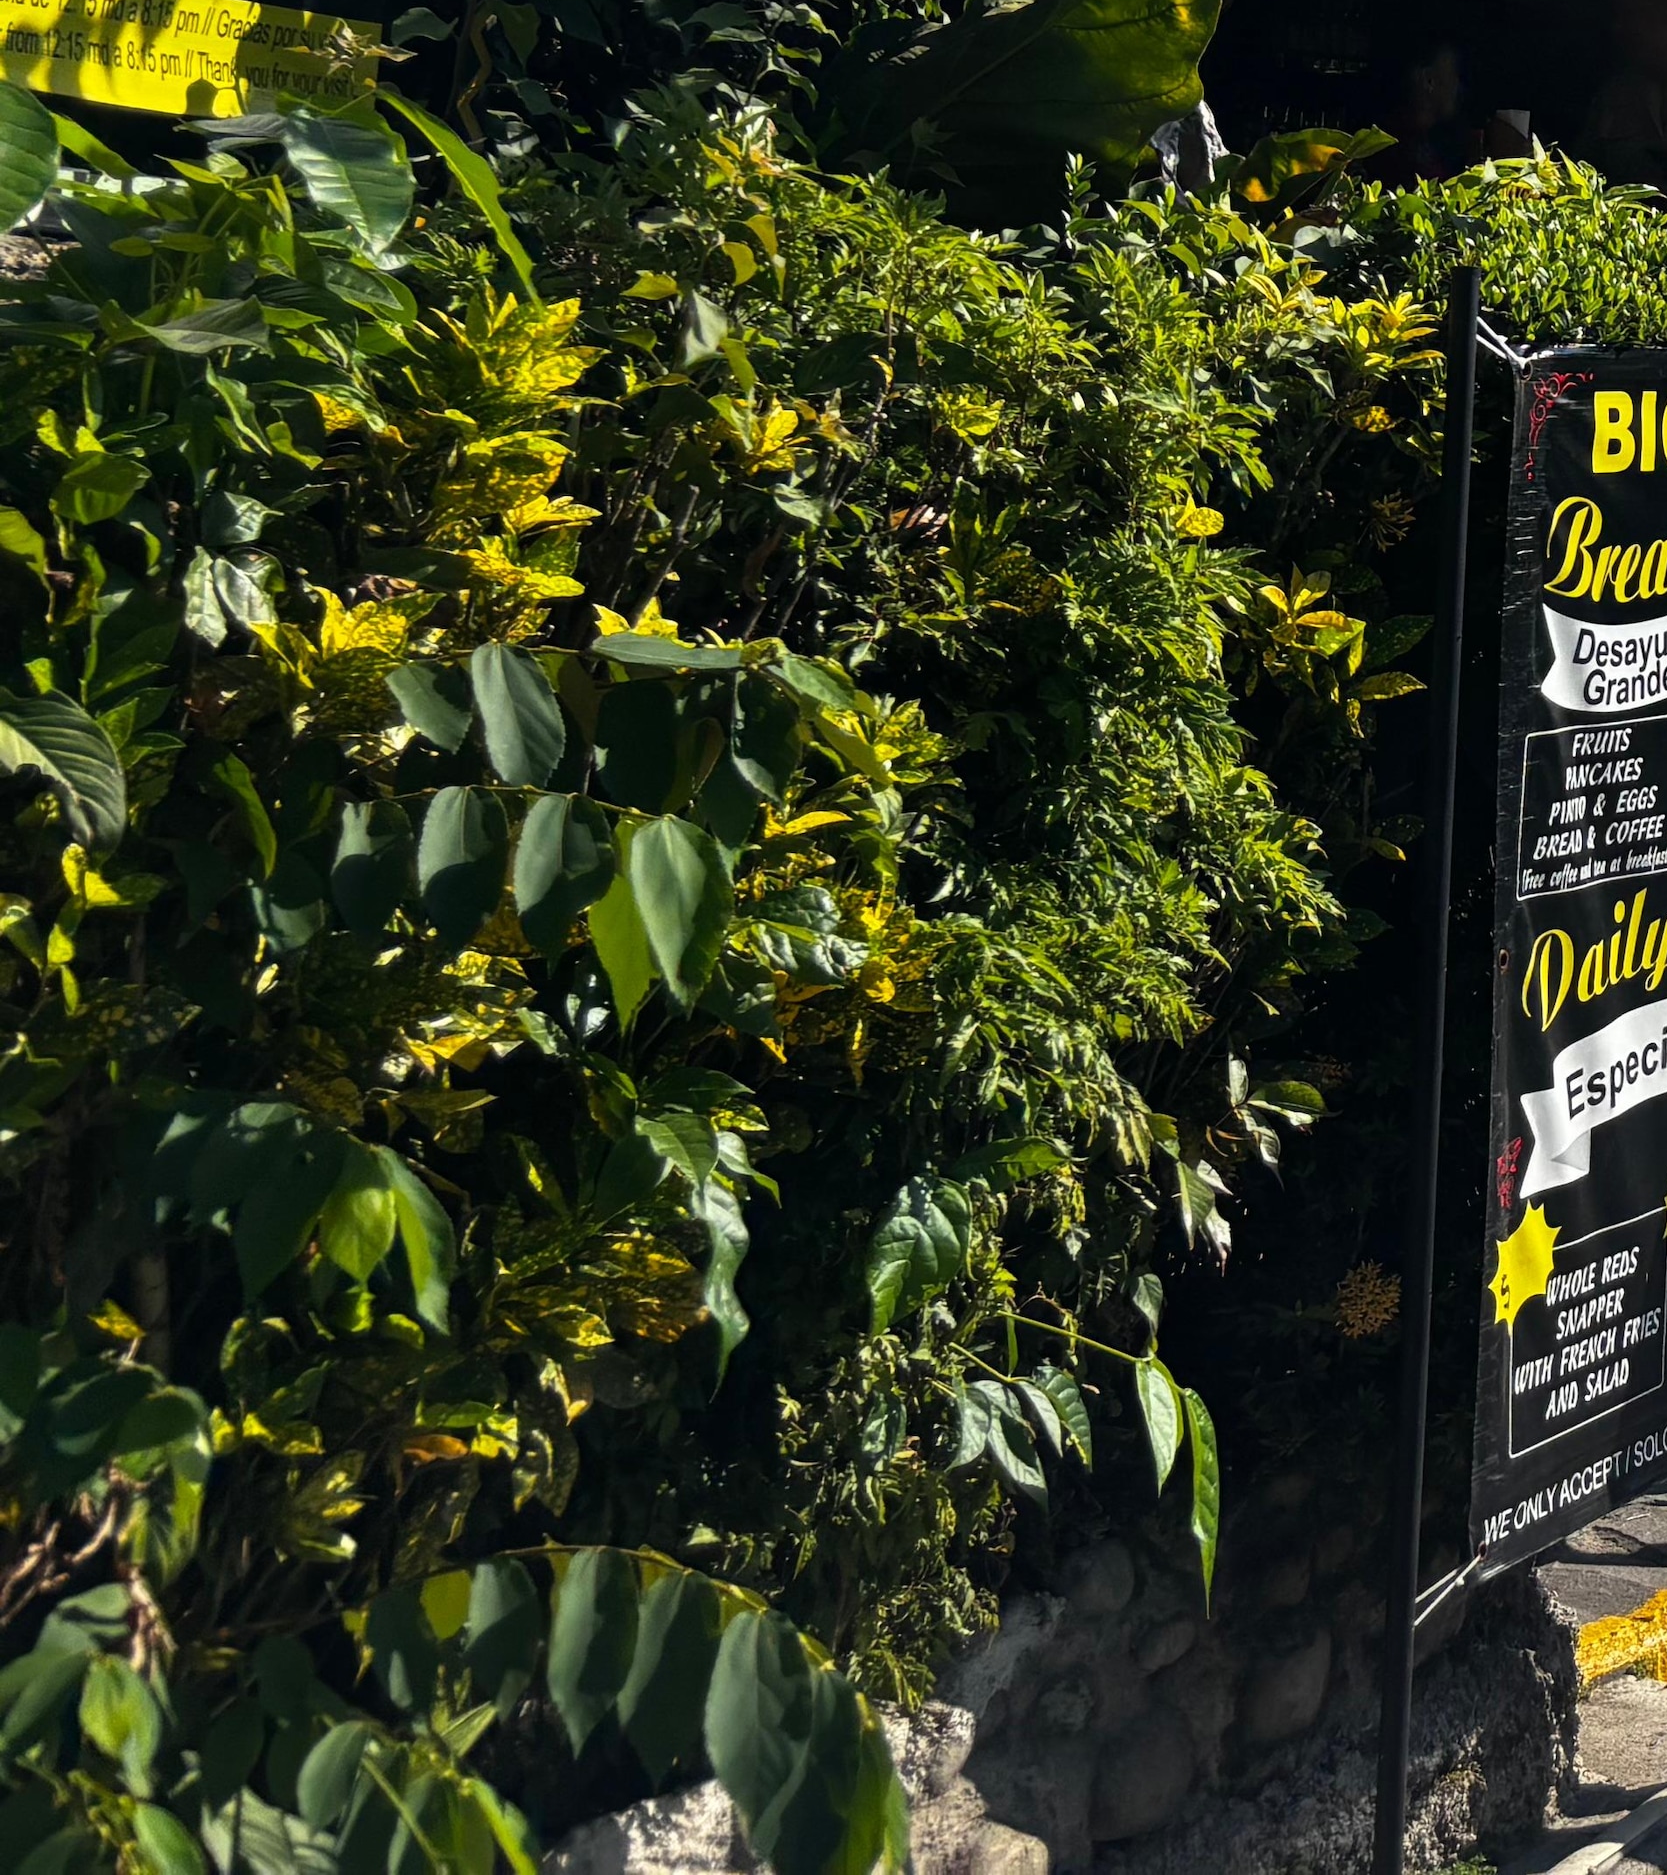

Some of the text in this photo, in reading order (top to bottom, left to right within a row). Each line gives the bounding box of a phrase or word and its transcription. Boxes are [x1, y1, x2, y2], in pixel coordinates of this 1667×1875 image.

[129, 1, 138, 23] a
[175, 10, 200, 37] pm
[114, 48, 122, 67] a
[160, 51, 182, 80] pm
[1572, 728, 1632, 758] FRUITS
[1565, 757, 1644, 791] PANCAKES
[1549, 785, 1658, 826] PINTO & EGGS
[1533, 814, 1666, 860] BREAD & COFFEE
[1546, 1246, 1640, 1307] WHOLE REDS
[1556, 1287, 1625, 1340] SNAPPER
[1514, 1307, 1662, 1395] WITH FRENCH FRIES
[1545, 1357, 1630, 1420] AND SALAD
[1484, 1511, 1511, 1546] WE
[1513, 1483, 1559, 1530] ONLY
[1559, 1455, 1622, 1509] ACCEPT
[1625, 1445, 1631, 1474] /
